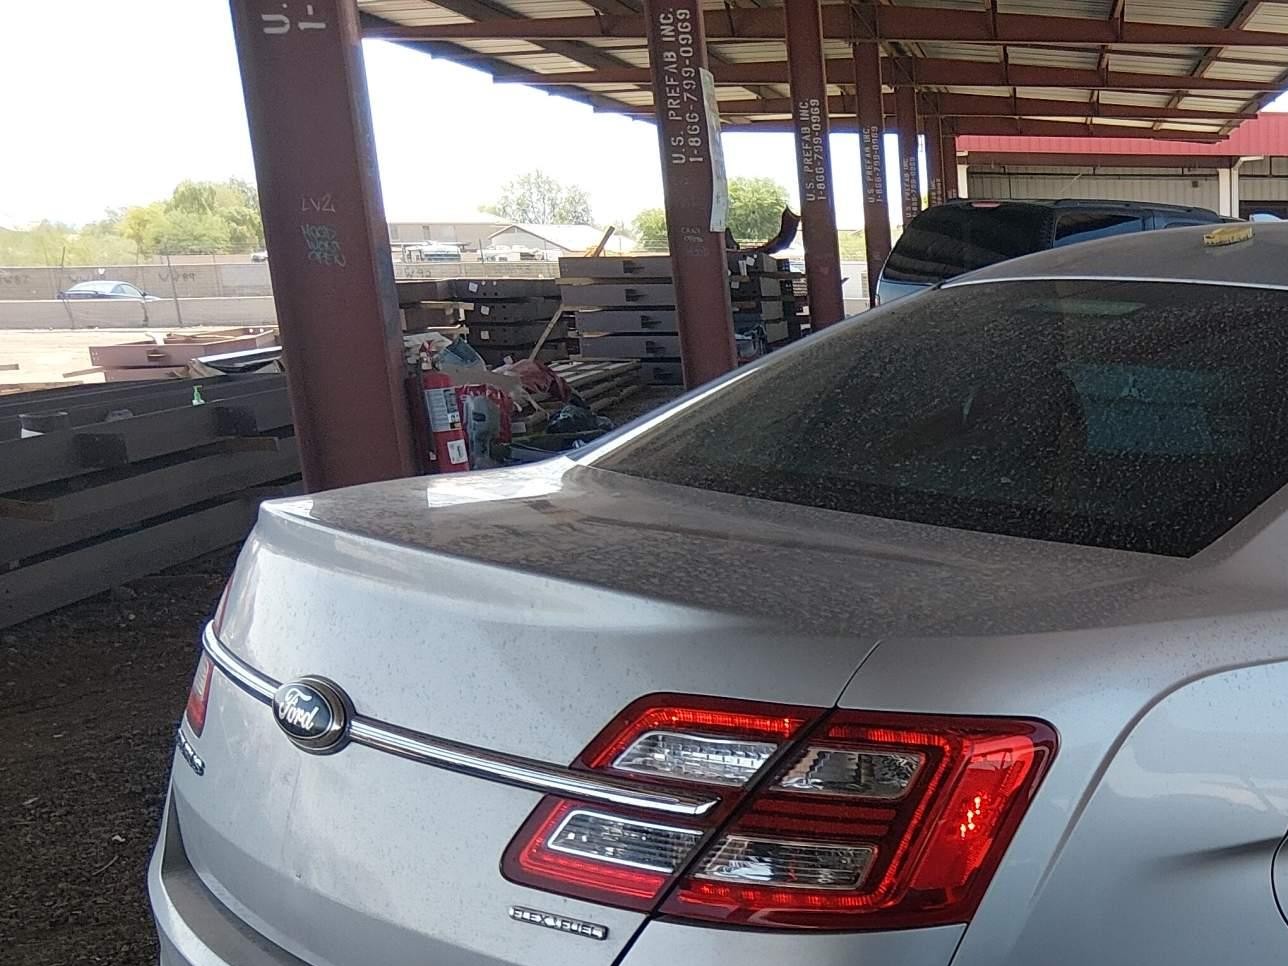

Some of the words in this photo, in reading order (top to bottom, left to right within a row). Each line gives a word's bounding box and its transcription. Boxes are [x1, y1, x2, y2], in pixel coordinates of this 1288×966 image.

[660, 8, 676, 42] INC.
[664, 51, 683, 121] PREFAB
[676, 9, 703, 162] 1-866-799-0969
[671, 131, 686, 164] U.S.
[801, 128, 814, 174] PREFAB
[279, 687, 319, 730] Ford
